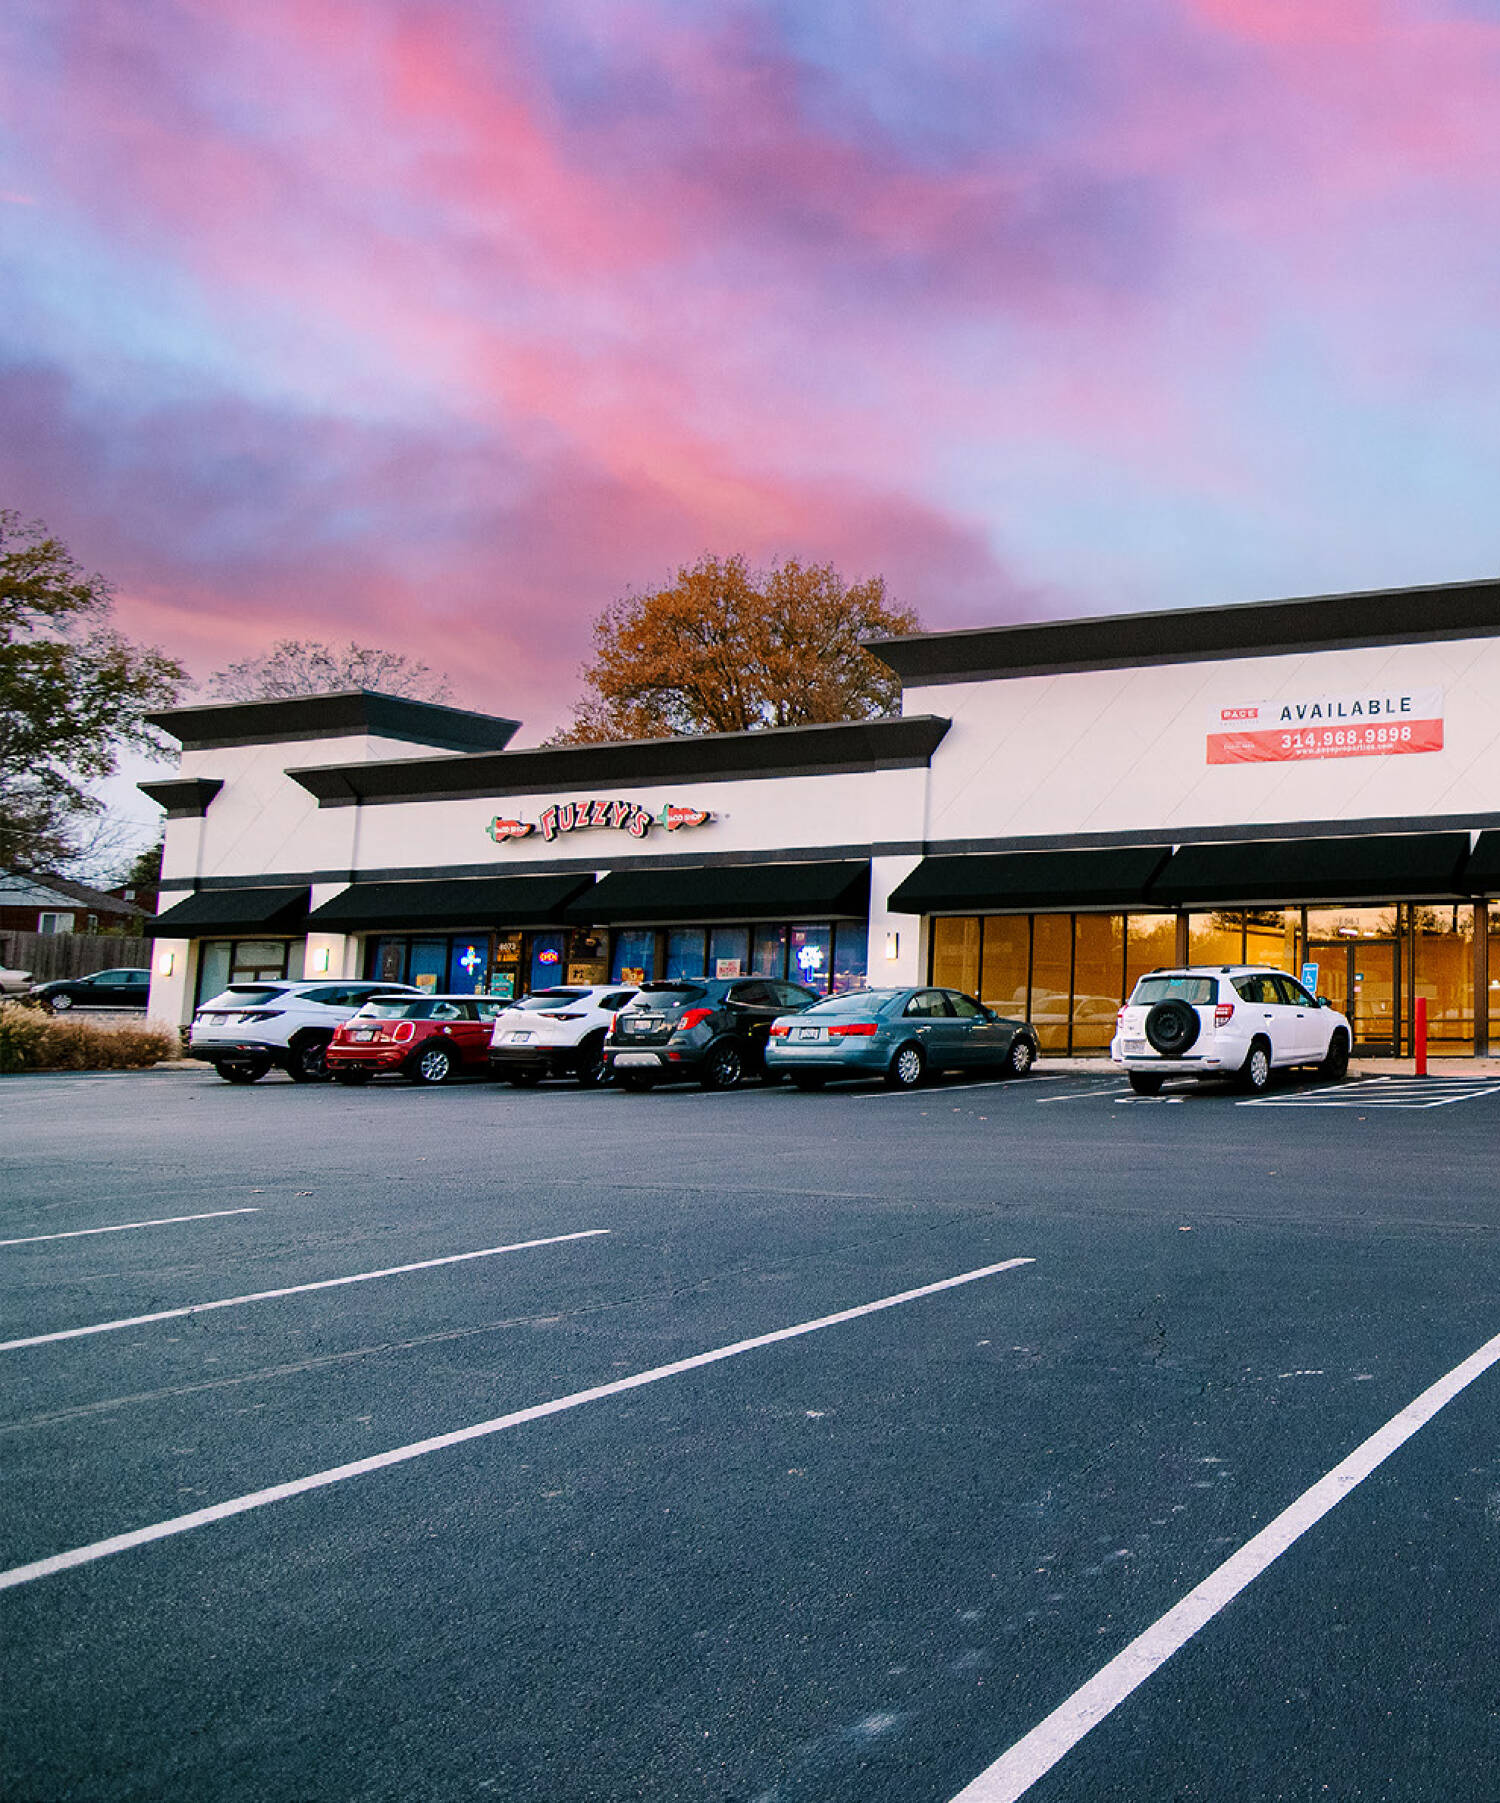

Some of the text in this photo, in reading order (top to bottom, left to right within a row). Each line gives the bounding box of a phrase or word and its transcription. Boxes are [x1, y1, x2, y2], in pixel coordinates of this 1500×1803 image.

[1223, 709, 1256, 718] PACE
[1280, 697, 1412, 721] AVAILABLE
[1281, 726, 1412, 749] 314.968.9898
[540, 801, 654, 842] FUZZY'S
